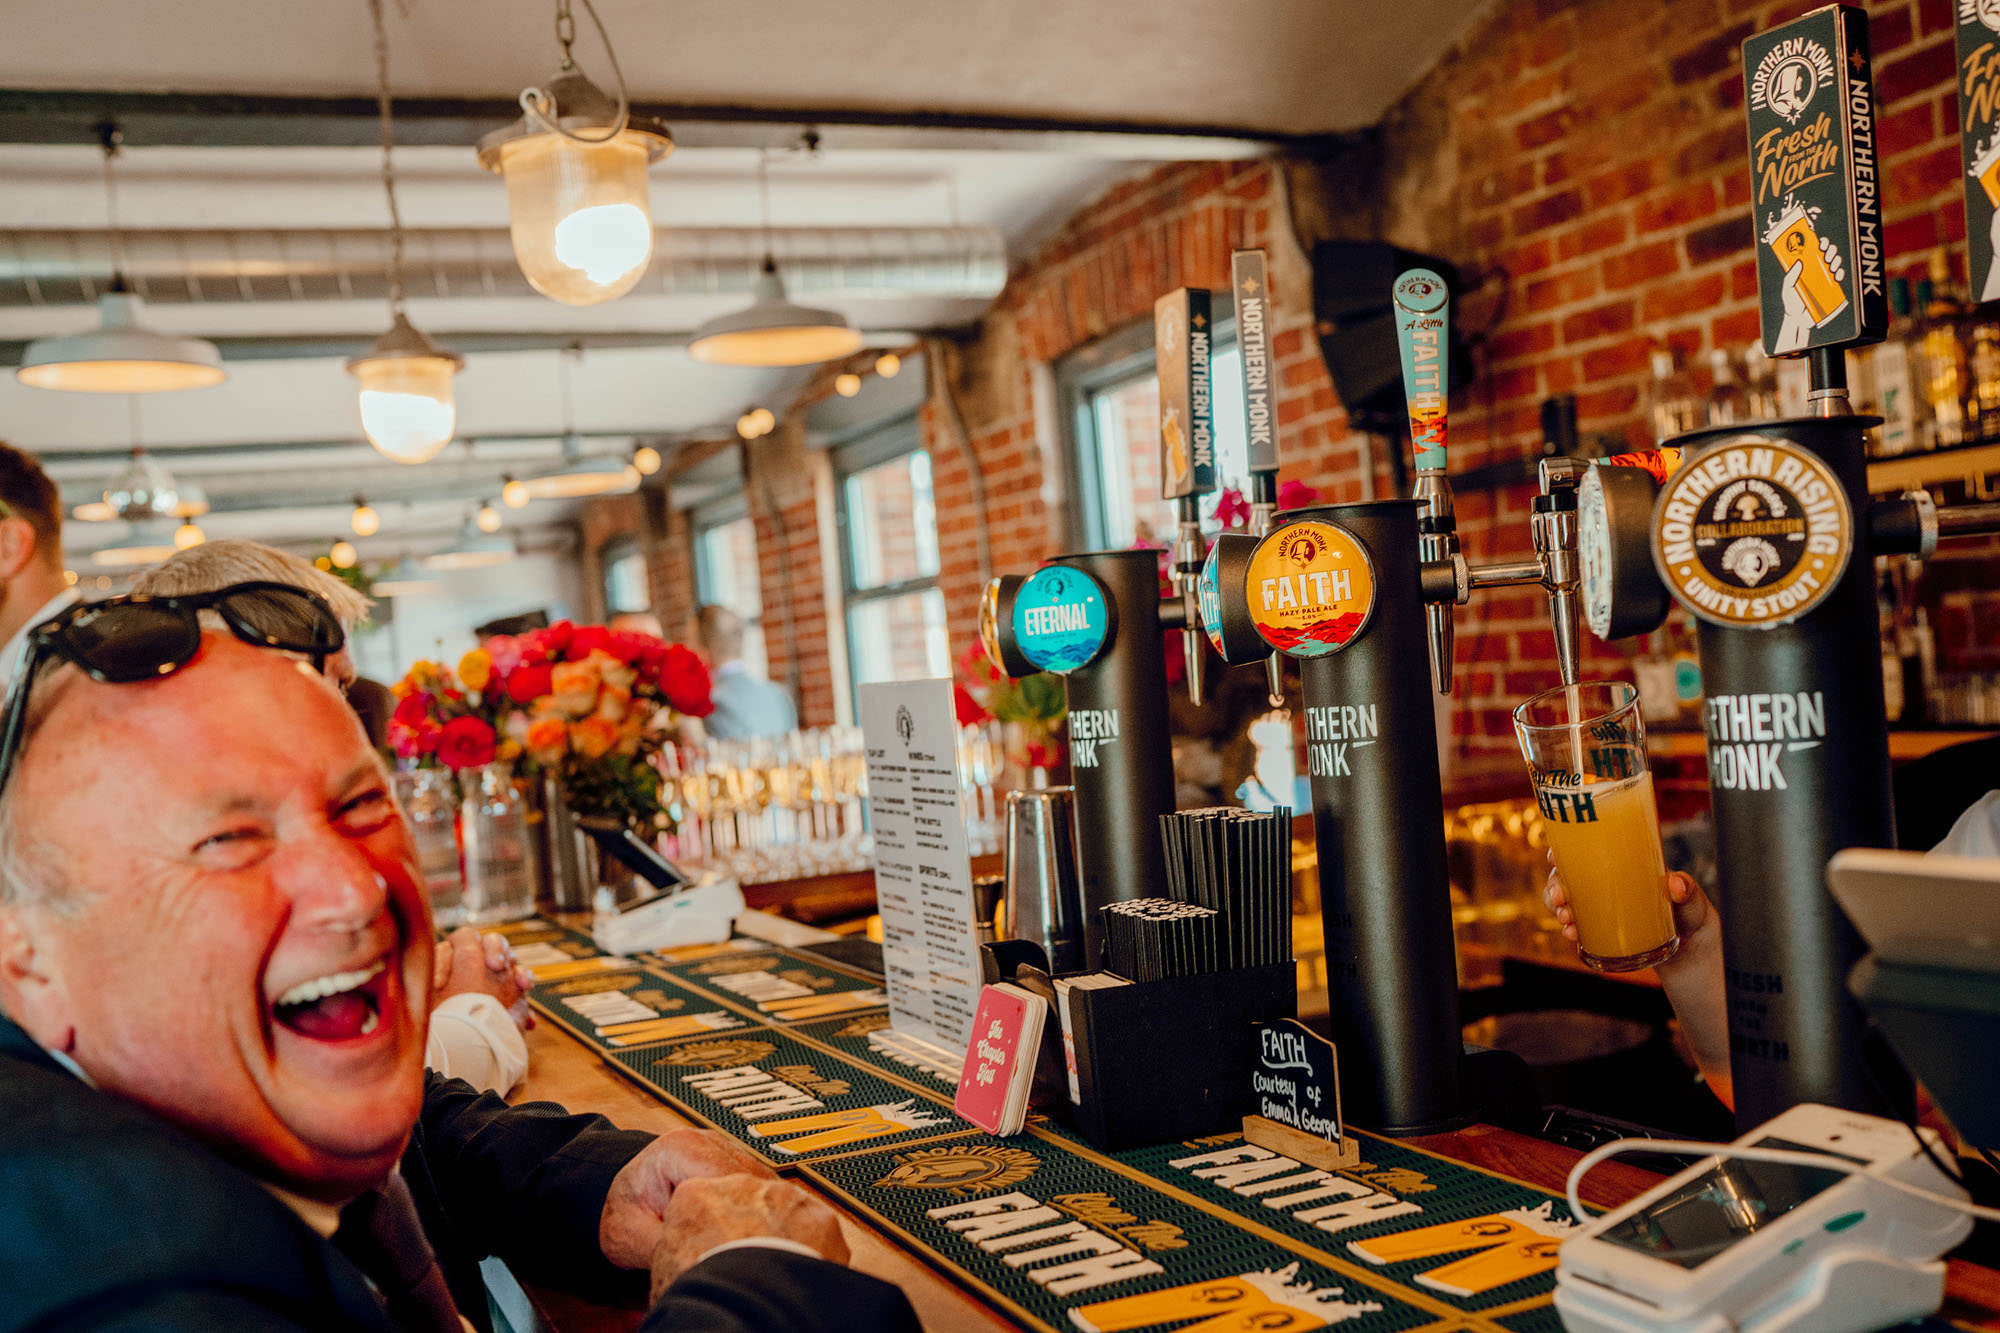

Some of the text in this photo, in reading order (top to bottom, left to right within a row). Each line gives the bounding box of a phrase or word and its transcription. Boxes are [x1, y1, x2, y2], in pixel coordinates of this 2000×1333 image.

[1751, 37, 1834, 104] NORTHERN MONK
[1755, 112, 1831, 173] Fresh
[1758, 140, 1839, 205] North
[1850, 79, 1882, 297] NORTHERN MONK
[1242, 298, 1271, 446] NORTHERN MONK
[1412, 330, 1440, 409] FAITH
[1191, 332, 1212, 468] NORTHERN MONK
[1662, 449, 1774, 565] NORTHERN
[1774, 450, 1840, 556] RISING
[1279, 528, 1328, 557] NORTHERN MONK
[1261, 568, 1353, 611] FAITH
[1279, 603, 1338, 617] HAZY PALE ALE
[1684, 570, 1821, 618] UNITY STOUT
[1024, 602, 1091, 636] ETERNAL
[1304, 703, 1378, 740] THERN
[1308, 742, 1351, 777] ONK
[1549, 768, 1581, 786] The
[1261, 1028, 1307, 1064] FAITH
[682, 1064, 826, 1121] FAITH
[1253, 1070, 1321, 1108] Courtesy of
[1261, 1096, 1293, 1125] Emma
[1301, 1107, 1341, 1144] George
[1168, 1143, 1424, 1234] FAITH
[925, 1191, 1165, 1297] FAITH
